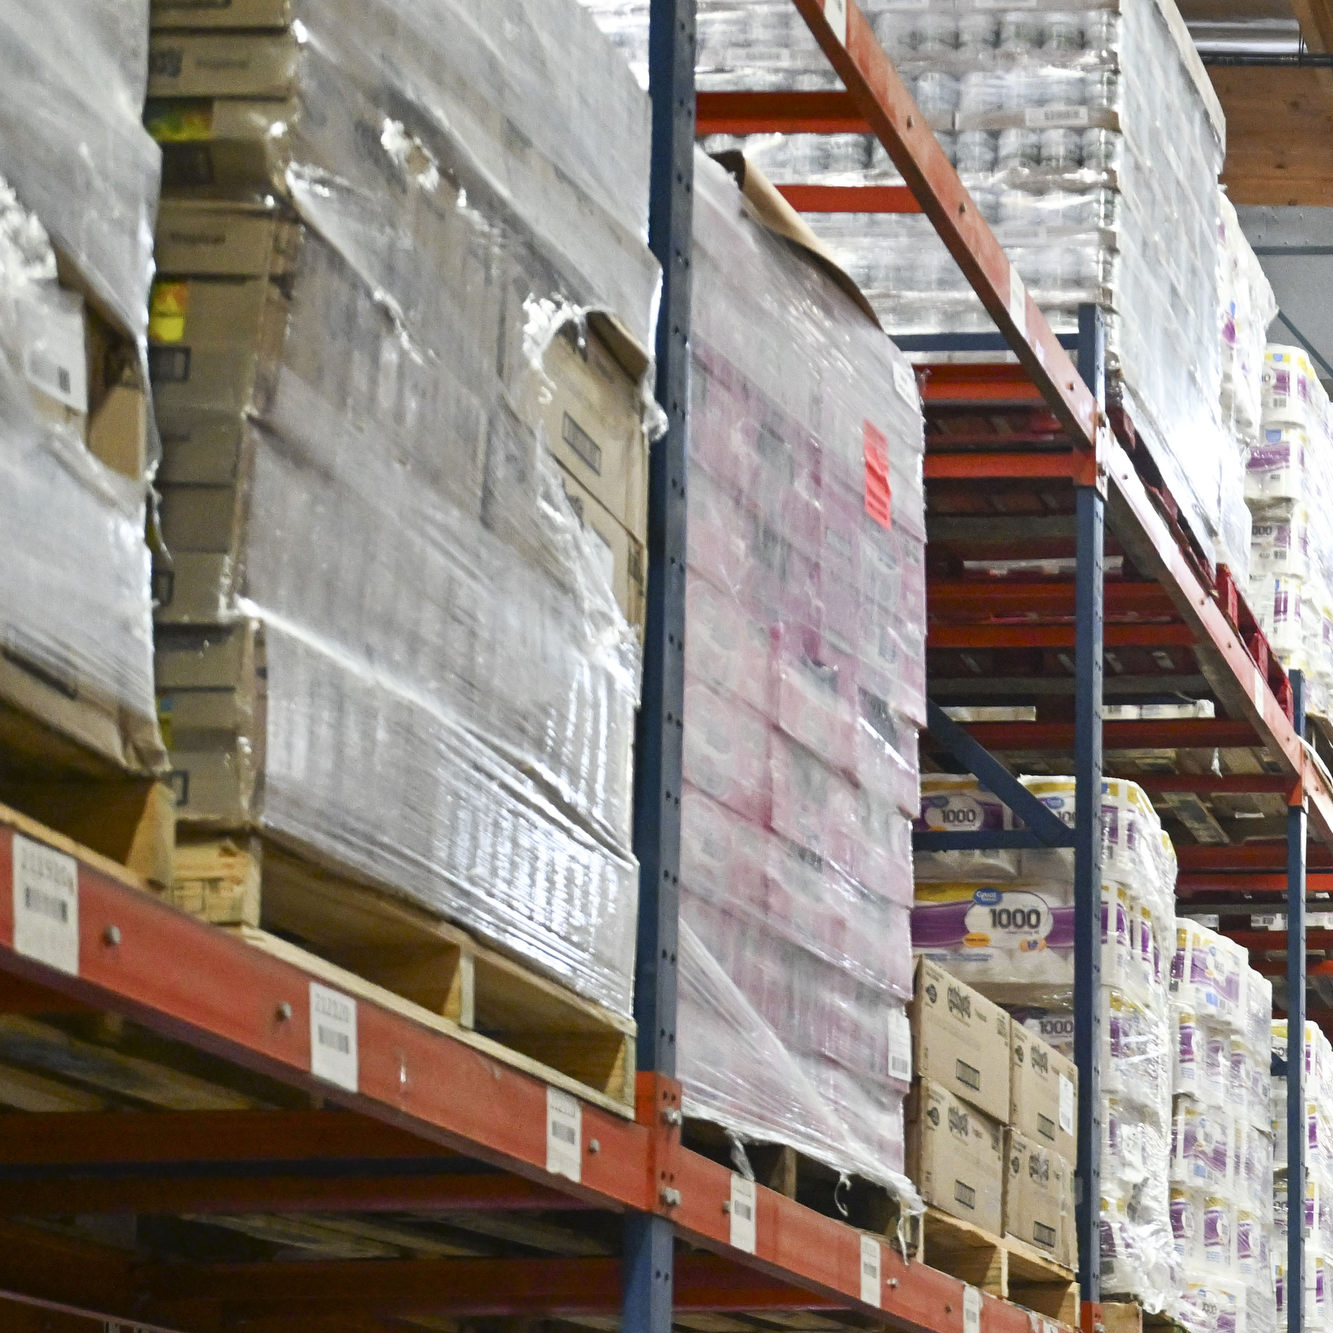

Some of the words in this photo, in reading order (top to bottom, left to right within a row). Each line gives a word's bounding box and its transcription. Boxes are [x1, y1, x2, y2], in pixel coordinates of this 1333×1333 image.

[1250, 526, 1272, 536] 000
[941, 809, 976, 824] 1000
[989, 908, 1041, 930] 1000
[1039, 1020, 1073, 1035] 1000
